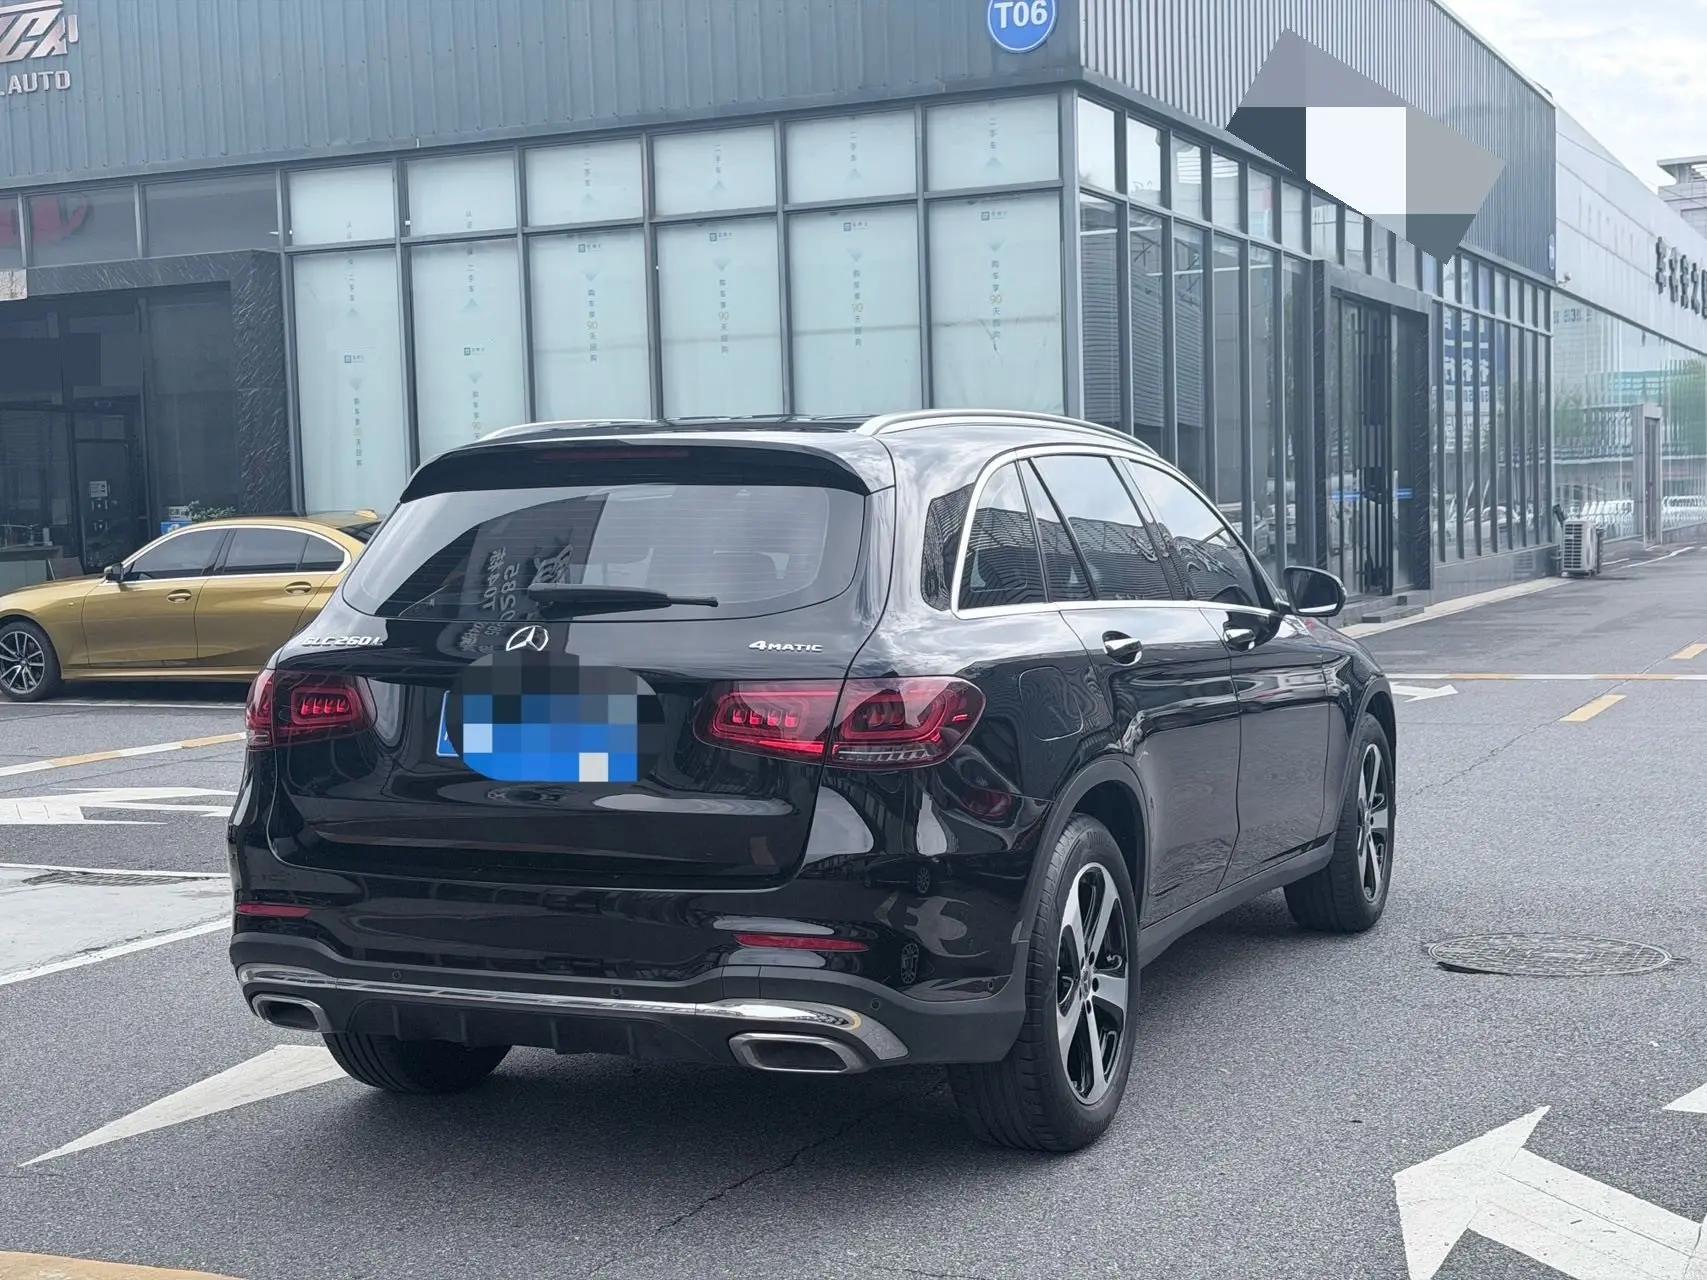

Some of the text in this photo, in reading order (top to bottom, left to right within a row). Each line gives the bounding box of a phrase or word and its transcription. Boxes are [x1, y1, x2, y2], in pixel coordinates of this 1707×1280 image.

[994, 0, 1048, 29] T06
[0, 70, 71, 96] AUTO
[748, 640, 824, 653] 4MATIC
